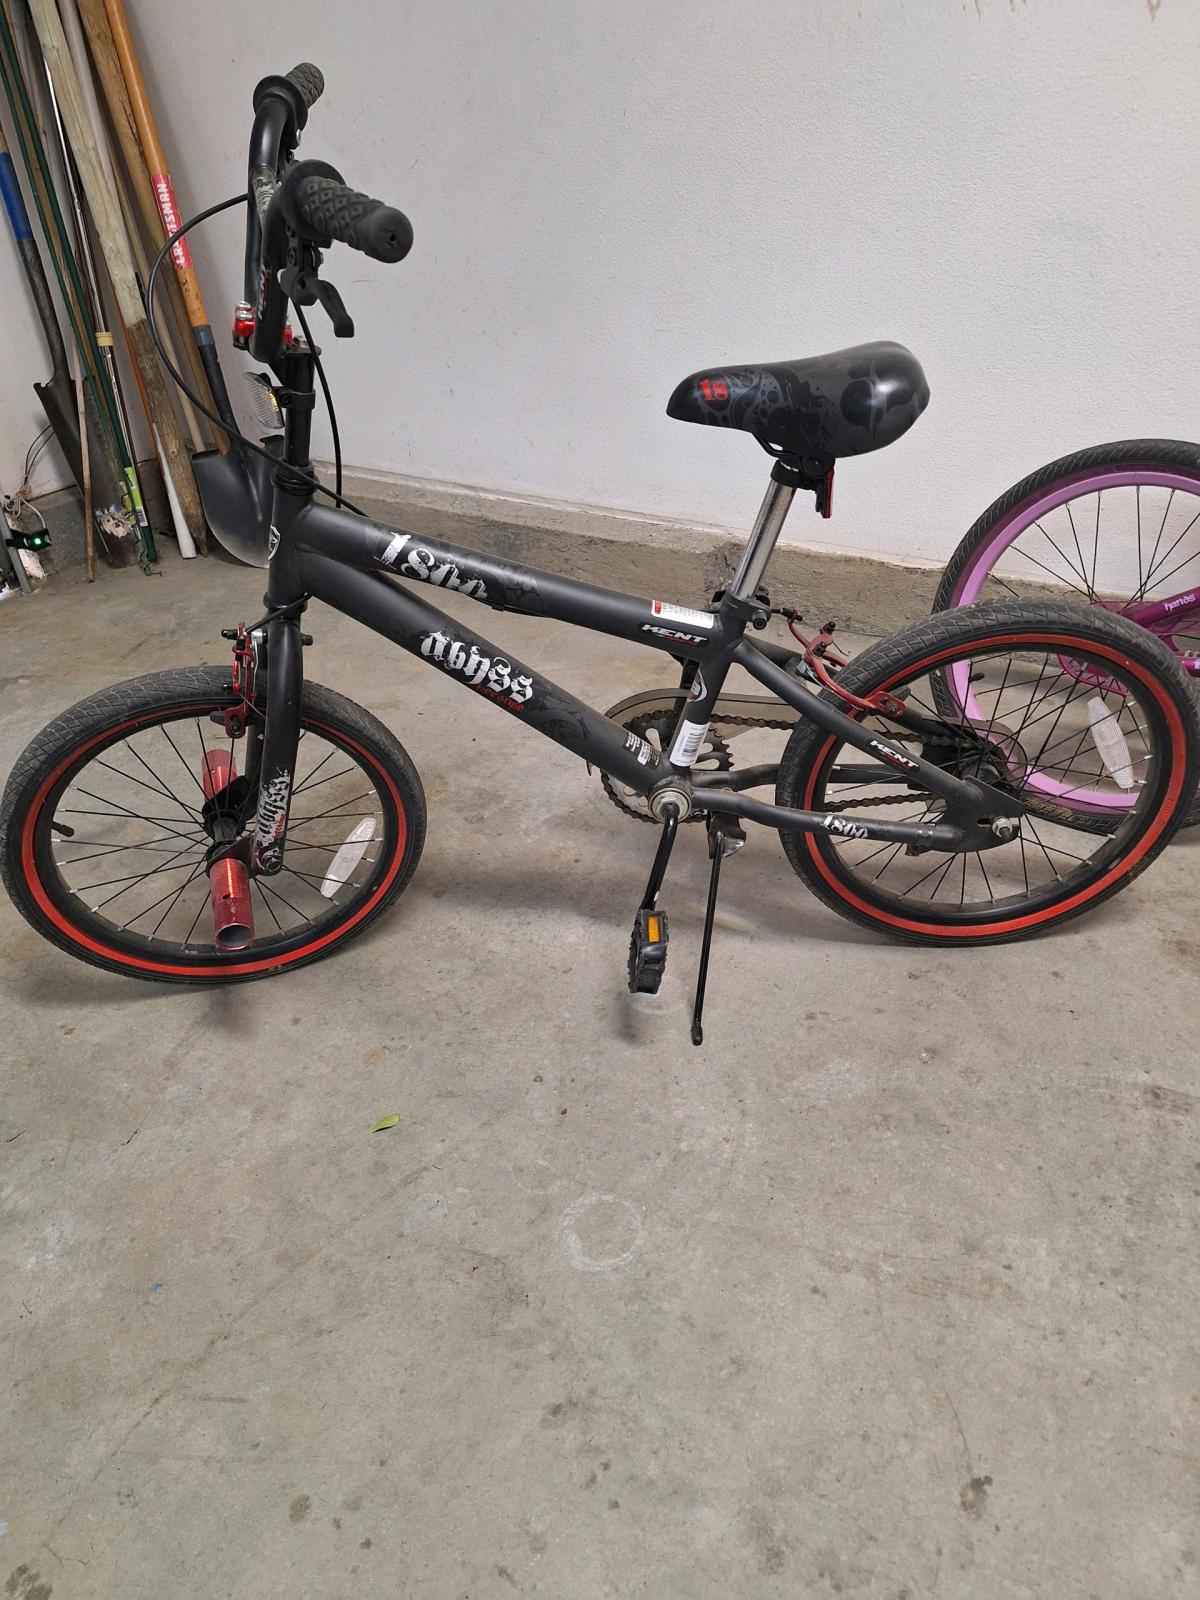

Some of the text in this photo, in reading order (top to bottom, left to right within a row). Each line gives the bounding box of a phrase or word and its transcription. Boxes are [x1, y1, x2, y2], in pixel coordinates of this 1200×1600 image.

[699, 379, 729, 401] 18
[641, 623, 707, 643] KENT
[870, 740, 919, 768] KENT
